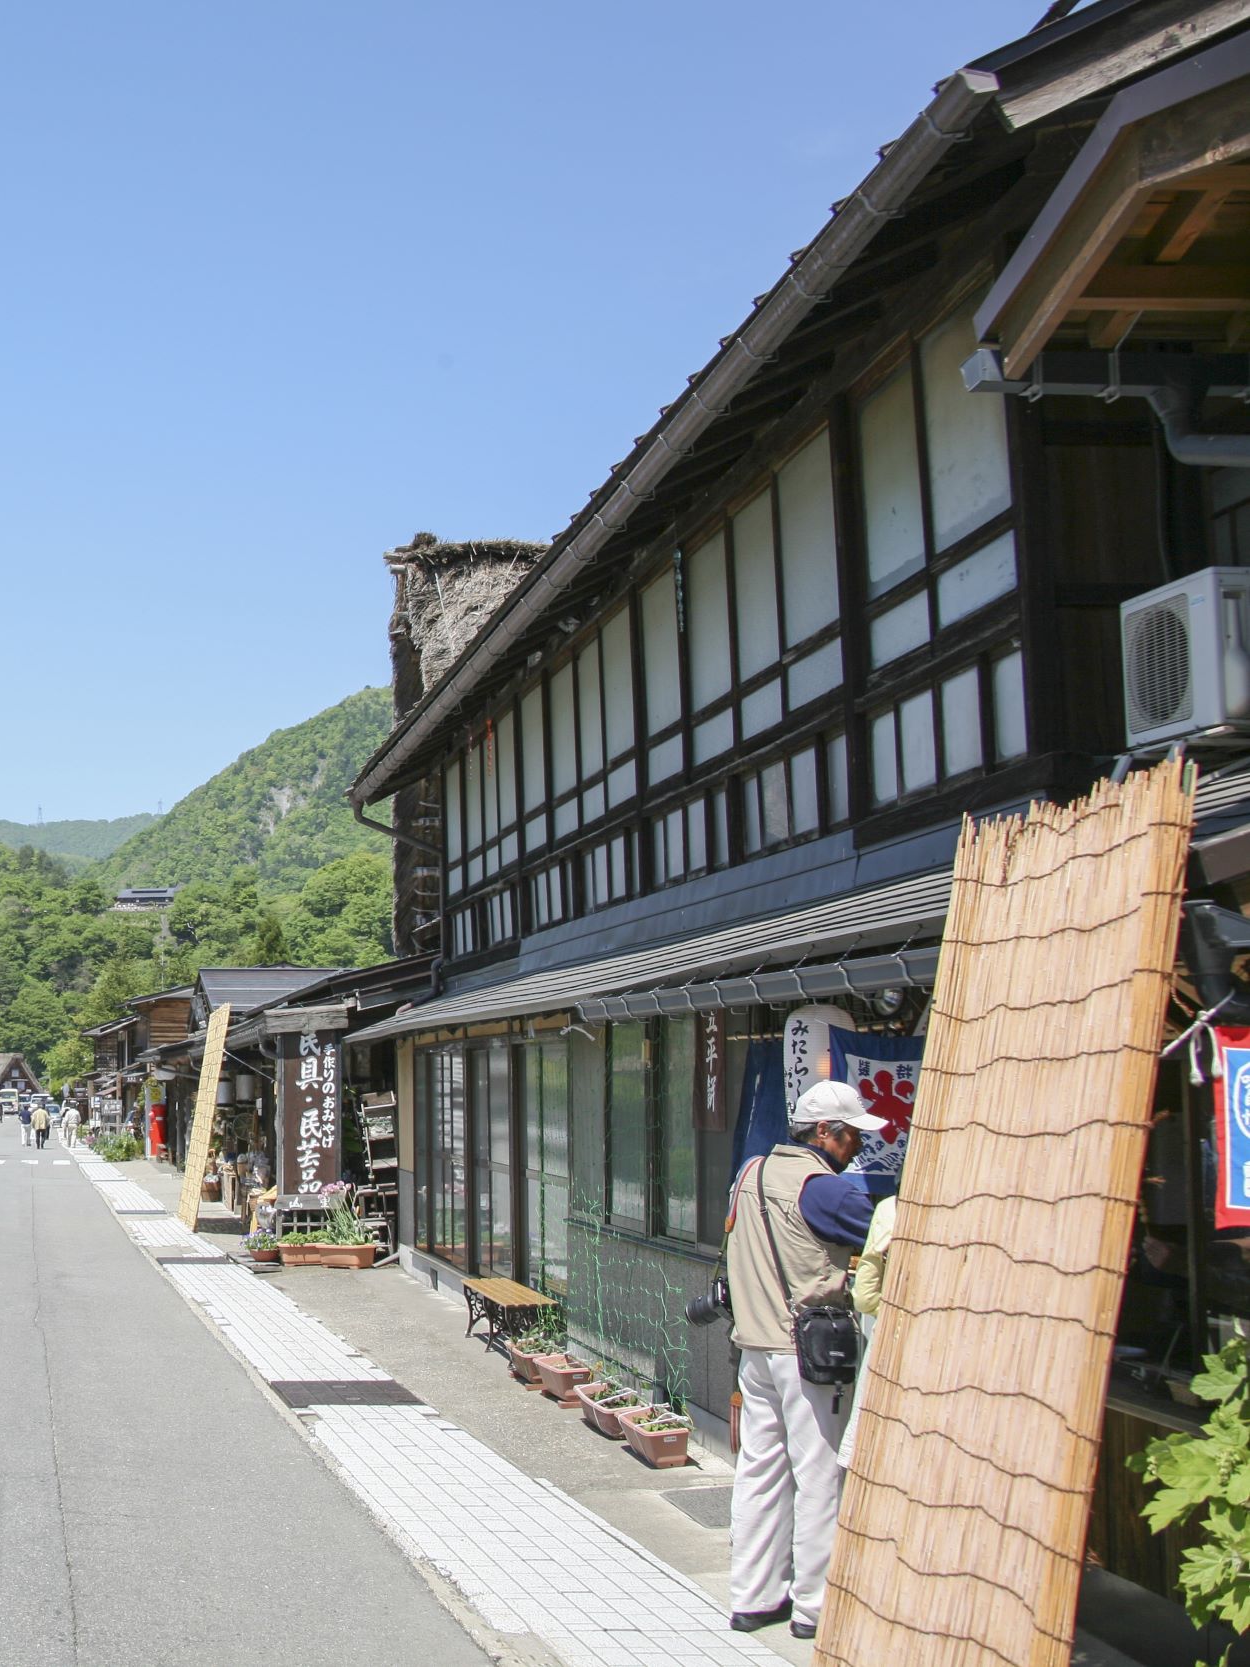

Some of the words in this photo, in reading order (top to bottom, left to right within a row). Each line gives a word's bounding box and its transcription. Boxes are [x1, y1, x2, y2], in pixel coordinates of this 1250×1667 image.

[295, 1033, 324, 1194] 民具・民芸品
